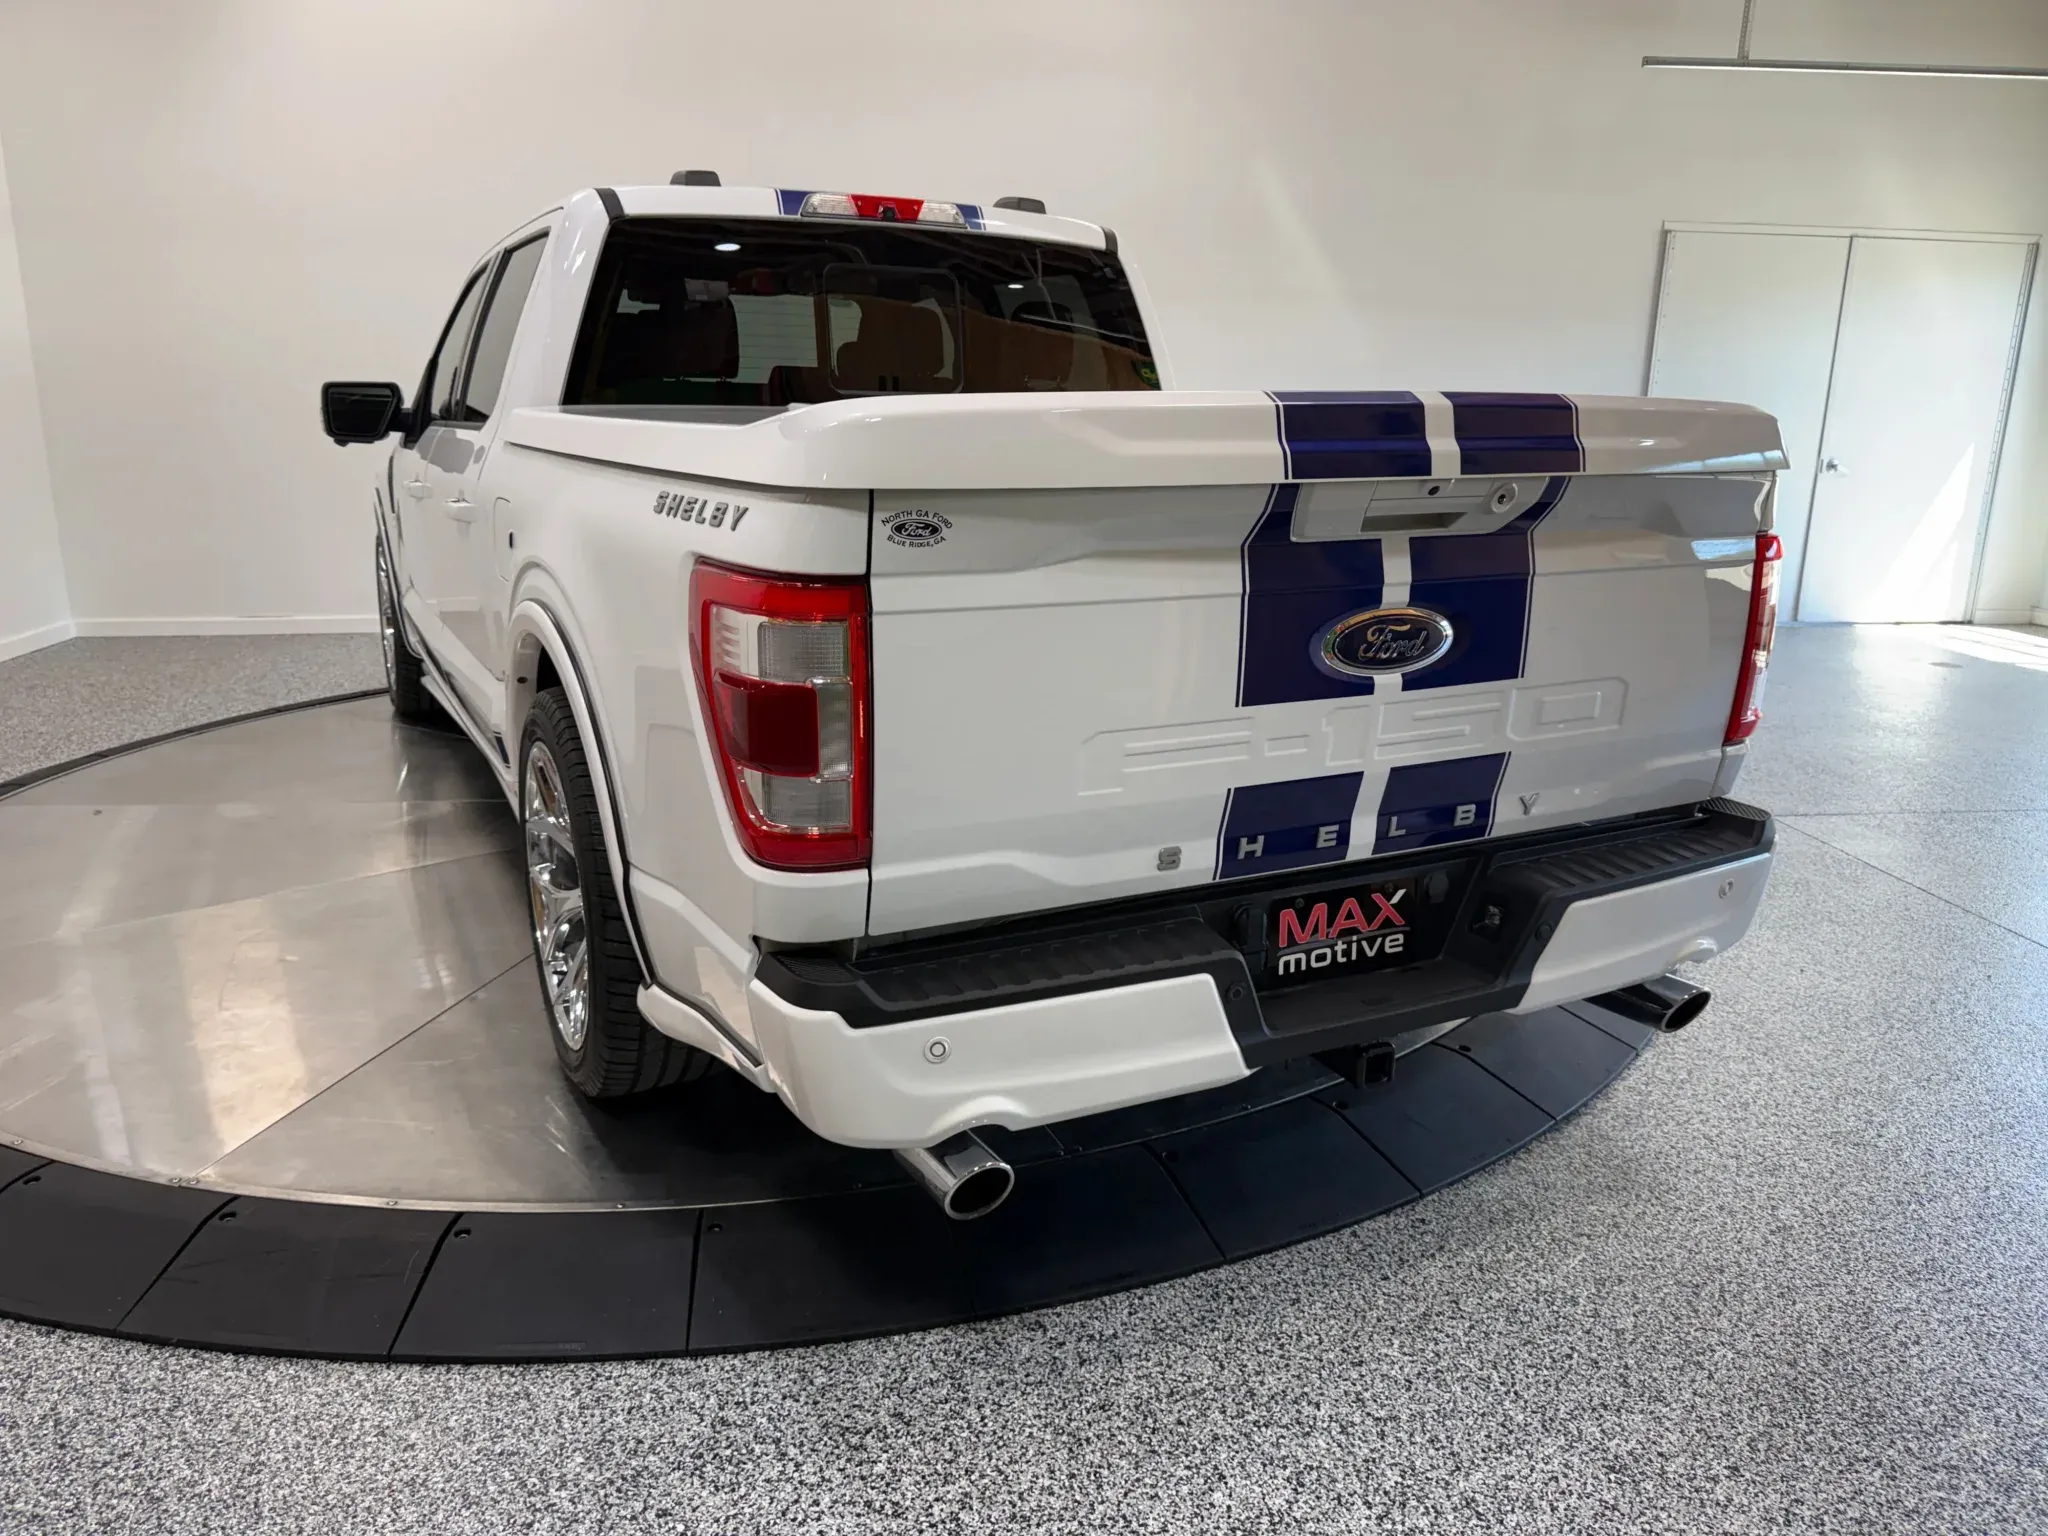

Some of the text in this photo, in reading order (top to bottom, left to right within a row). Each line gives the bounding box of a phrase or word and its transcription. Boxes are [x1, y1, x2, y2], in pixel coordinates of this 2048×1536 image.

[653, 491, 749, 532] SHELBY
[881, 509, 953, 529] NORTH GA FORD
[901, 522, 933, 536] Ford
[887, 534, 907, 547] BLUE
[933, 535, 946, 545] GA
[1358, 624, 1428, 660] Ford
[1078, 677, 1630, 795] F-150
[1157, 792, 1540, 871] SHELBY
[1278, 889, 1405, 948] MAX
[1278, 932, 1404, 976] motive
